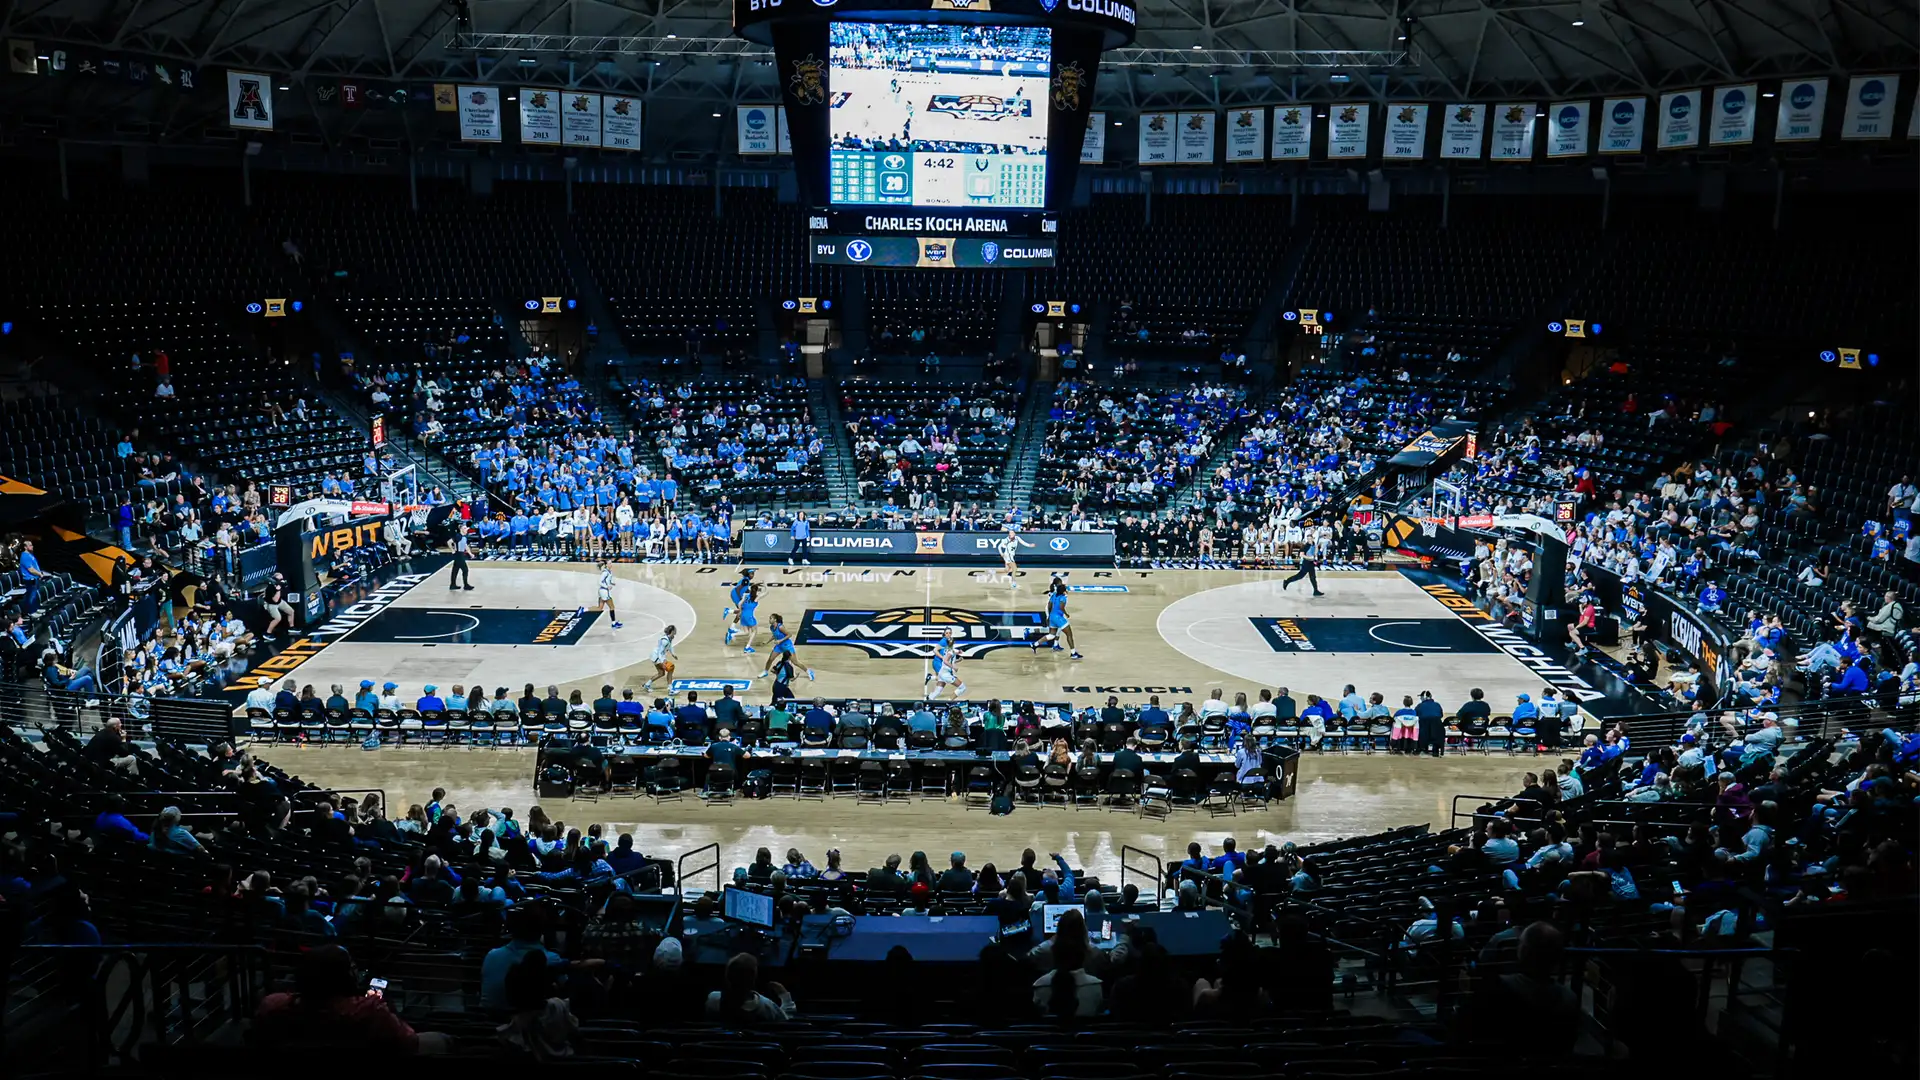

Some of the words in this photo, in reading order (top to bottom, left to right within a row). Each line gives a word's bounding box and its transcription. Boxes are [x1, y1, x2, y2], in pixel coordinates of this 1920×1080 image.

[1067, 0, 1136, 26] COLUMBIA
[473, 129, 490, 137] 2025
[533, 131, 549, 139] 2013
[574, 134, 589, 142] 2014
[1723, 130, 1742, 138] 2009
[614, 137, 629, 146] 2015
[1611, 139, 1630, 148] 2007
[1283, 147, 1299, 155] 2013
[1339, 146, 1355, 154] 2015
[1395, 146, 1412, 154] 2016
[1452, 146, 1470, 154] 2017
[1503, 147, 1521, 155] 2024
[924, 158, 955, 169] 4:42
[865, 215, 923, 231] CHARLES
[925, 216, 963, 232] KOCH
[965, 217, 1008, 233] ARENA
[817, 245, 836, 255] BYU
[1003, 247, 1053, 259] COLUMBIA
[1302, 324, 1323, 335] 7:19
[1419, 439, 1452, 448] WBIT
[273, 494, 286, 502] 28
[1558, 511, 1570, 519] 28
[976, 538, 1005, 549] BY
[307, 598, 320, 609] WBIT
[308, 573, 432, 636] WICHITA
[1421, 584, 1496, 621] WBIT
[1622, 594, 1643, 609] WBIT
[532, 620, 568, 643] WBIT
[557, 617, 583, 637] WICHITA
[812, 623, 1058, 638] WBIT
[1276, 619, 1308, 642] WBIT
[1270, 624, 1292, 644] WICHITA
[1671, 611, 1701, 659] ELEVATE
[1702, 640, 1717, 672] THE
[223, 638, 329, 691] WBIT
[1475, 623, 1606, 702] WICHITA
[674, 680, 748, 690] Hellas
[1096, 686, 1193, 694] KOCH
